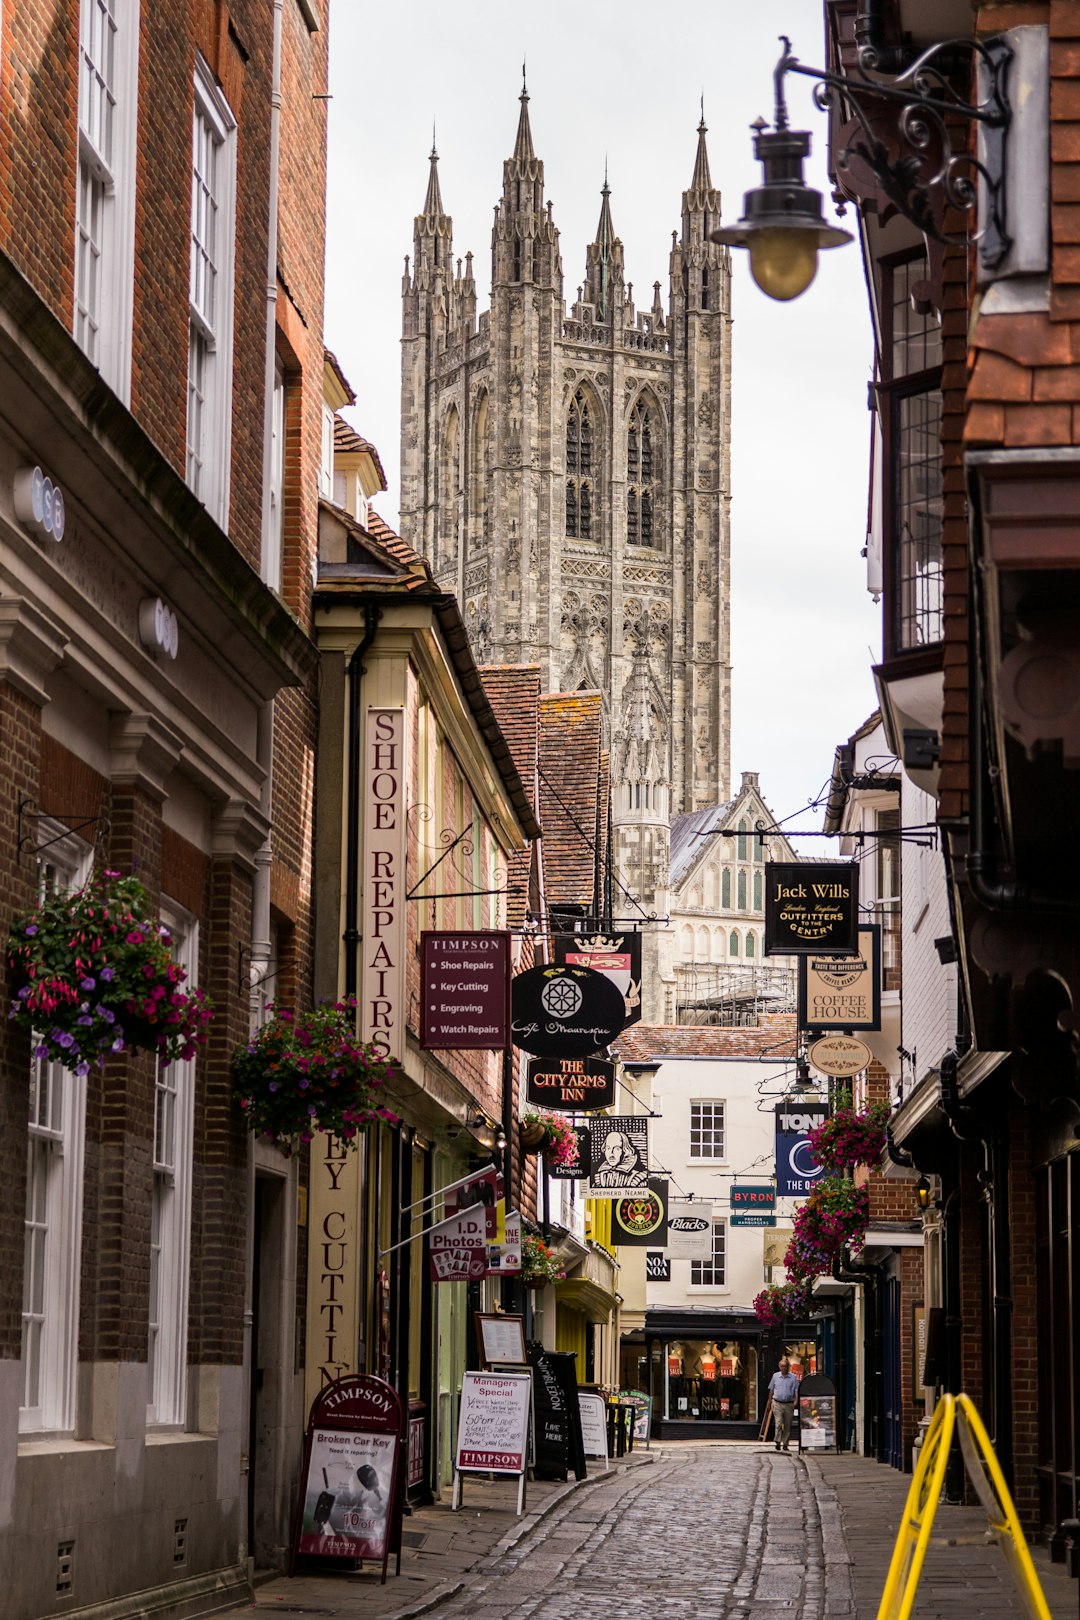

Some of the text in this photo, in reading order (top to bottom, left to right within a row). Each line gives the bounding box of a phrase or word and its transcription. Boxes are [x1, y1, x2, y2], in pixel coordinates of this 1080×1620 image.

[369, 713, 398, 1060] SHOE REPAIRS
[774, 884, 850, 902] Jack Wills
[780, 912, 843, 920] OUTFITTERS
[790, 923, 833, 936] GENTRY
[432, 940, 500, 950] TIMPSON
[441, 961, 494, 971] Shoe Repairs
[441, 982, 488, 992] Key Cutting
[813, 996, 866, 1006] COFFEE
[441, 1004, 483, 1014] Engraving
[441, 1025, 499, 1035] Watch Repairs
[560, 1060, 584, 1073] THE
[534, 1073, 607, 1088] CITY ARMS
[561, 1089, 585, 1101] INN
[780, 1114, 824, 1130] TONI
[556, 1167, 583, 1176] Designs
[787, 1180, 802, 1190] THE
[734, 1193, 773, 1201] BYRON
[458, 1222, 482, 1234] I.D.
[671, 1219, 706, 1229] Blacks
[434, 1236, 482, 1247] Photos
[318, 1132, 347, 1390] EY CUTTIN
[646, 1257, 668, 1267] NOA
[646, 1267, 668, 1276] NOA
[473, 1378, 518, 1388] Managers
[479, 1388, 513, 1397] Special
[324, 1388, 392, 1413] TIMPSON
[545, 1421, 560, 1431] LIVE
[317, 1434, 391, 1448] Broken Car Key
[545, 1433, 563, 1441] HERE
[463, 1453, 519, 1464] TIMPSON
